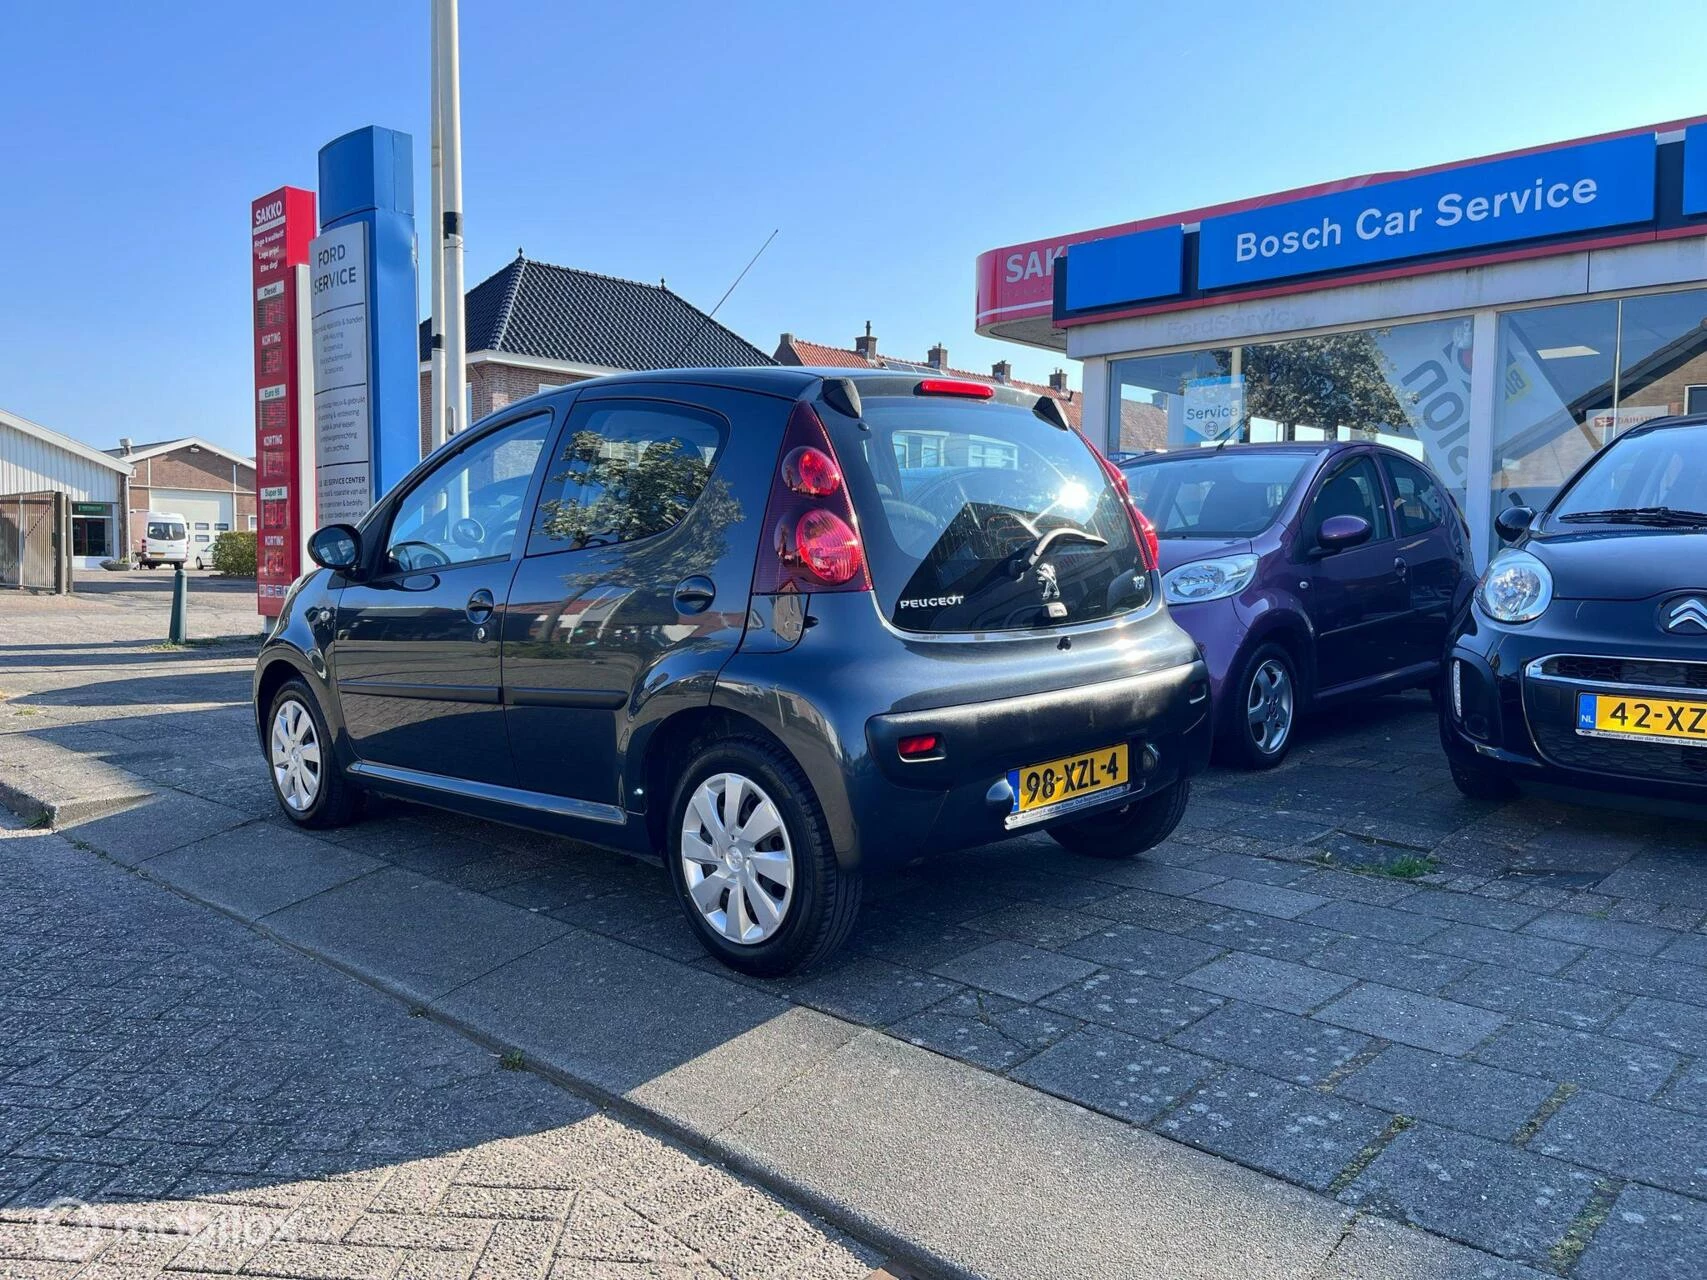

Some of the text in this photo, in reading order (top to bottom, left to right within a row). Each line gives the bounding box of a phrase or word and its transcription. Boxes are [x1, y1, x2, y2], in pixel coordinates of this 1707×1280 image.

[255, 200, 283, 226] SAKKO
[1236, 177, 1598, 263] Bosch Car Service
[318, 244, 345, 269] FORD
[314, 266, 356, 296] SERVICE
[1186, 404, 1239, 420] Service
[264, 488, 277, 498] Super
[900, 594, 964, 609] PEUGEOT
[1581, 714, 1594, 724] NL
[1026, 752, 1119, 803] 98-XZL-4
